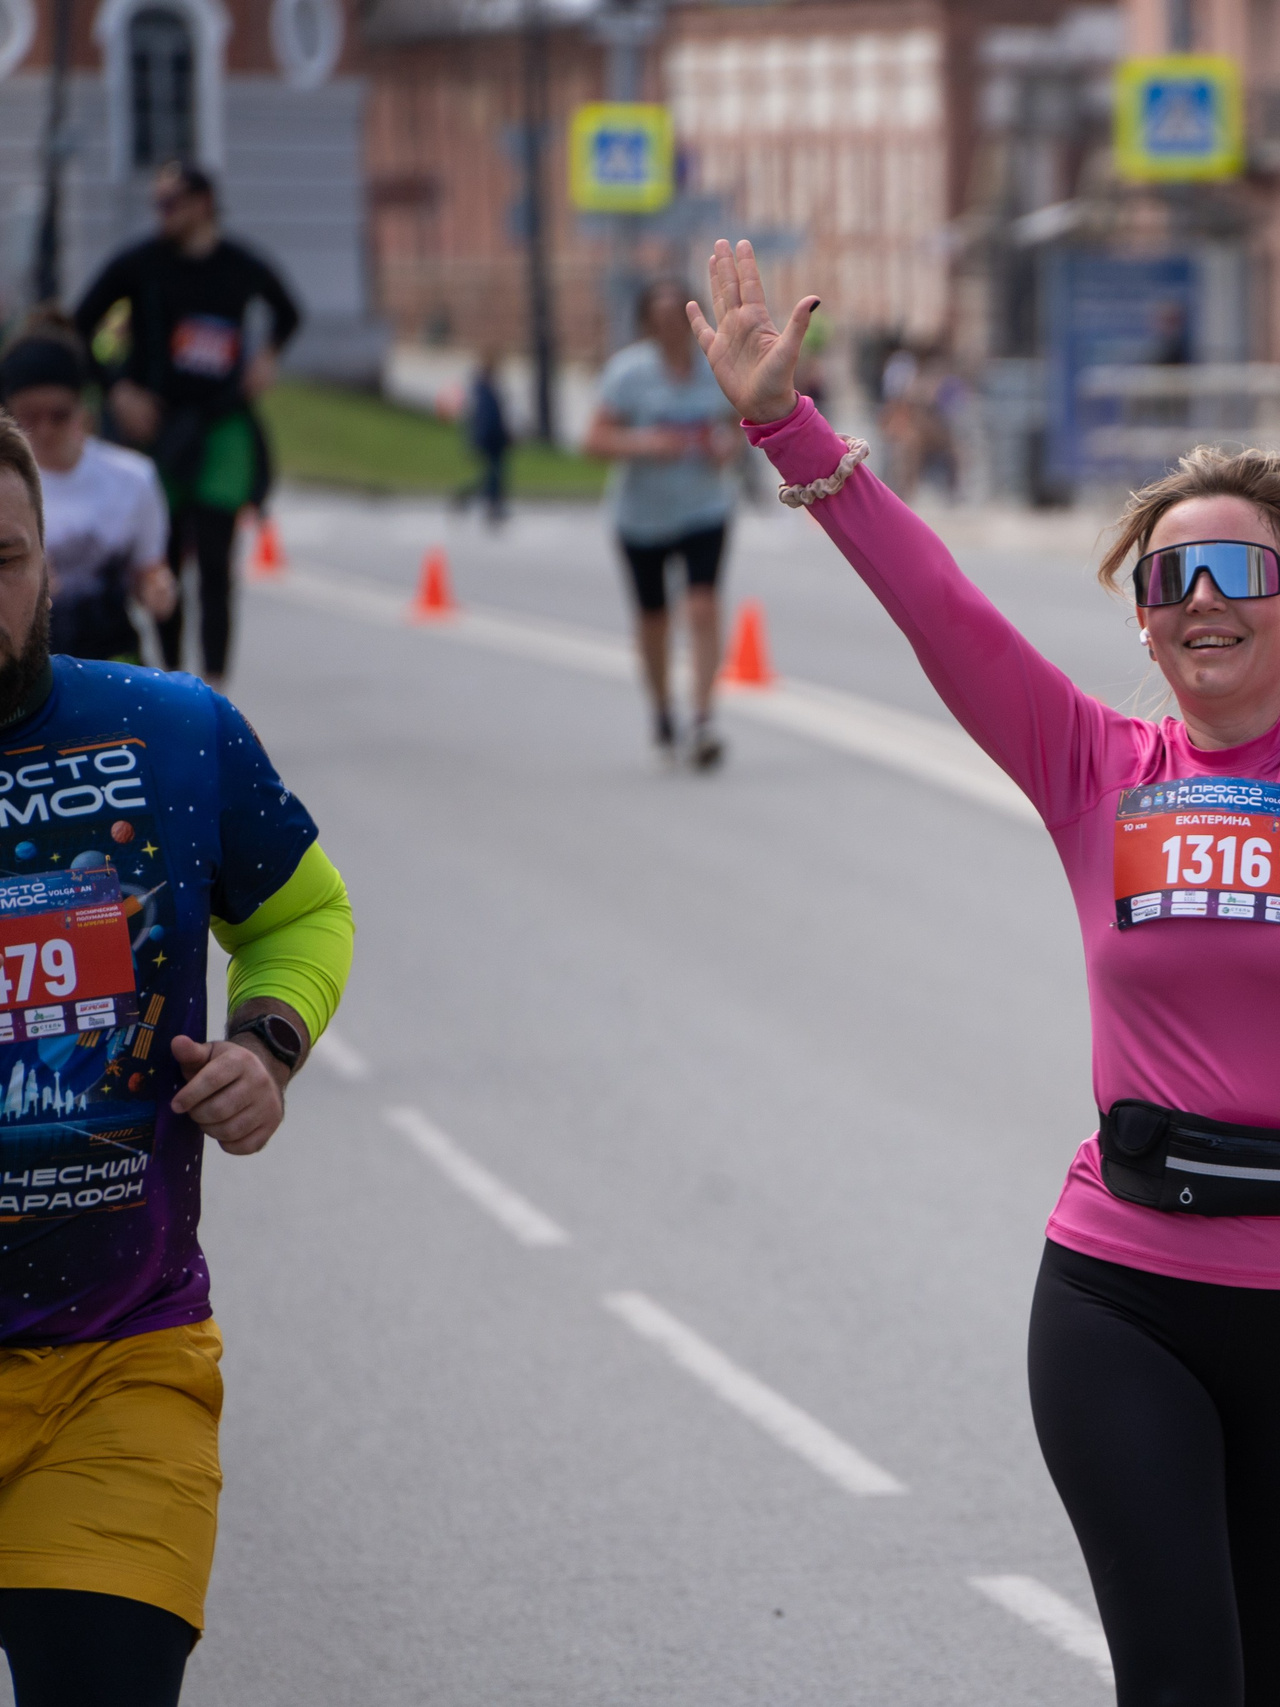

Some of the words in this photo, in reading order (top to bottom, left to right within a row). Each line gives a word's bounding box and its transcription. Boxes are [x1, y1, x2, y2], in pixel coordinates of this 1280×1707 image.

[1178, 785, 1190, 795] Я
[1191, 784, 1263, 796] ПРОСТО
[1177, 794, 1262, 806] КОСМОС
[1175, 815, 1251, 827] ЕКАТЕРИНА
[1123, 823, 1134, 832] 10
[1162, 835, 1272, 888] 1316
